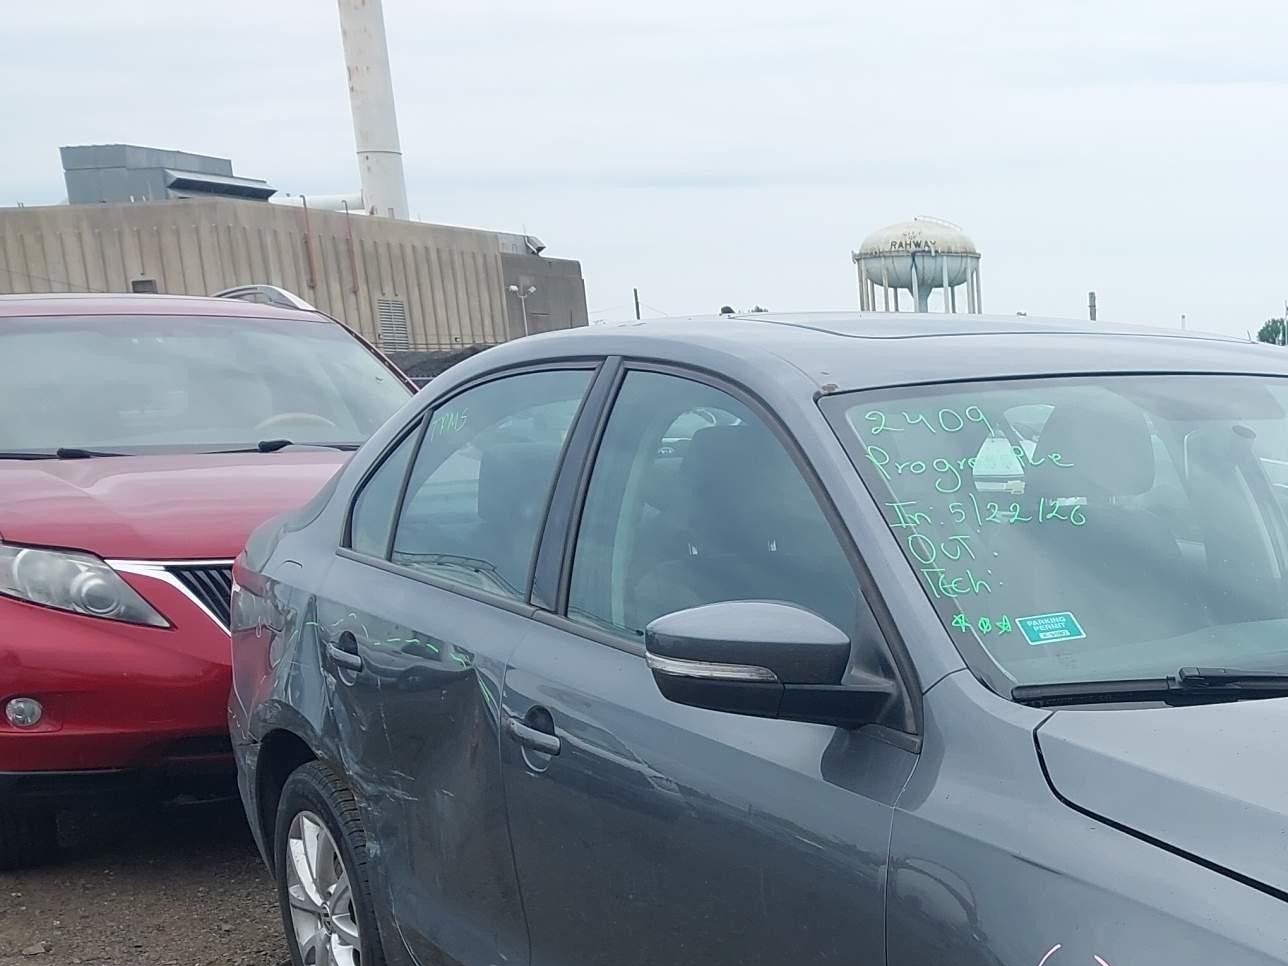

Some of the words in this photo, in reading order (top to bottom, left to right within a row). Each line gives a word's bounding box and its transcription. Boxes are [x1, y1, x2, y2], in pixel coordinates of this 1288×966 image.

[889, 240, 937, 250] RAHWAY
[864, 405, 996, 437] 2409
[1027, 616, 1066, 627] PARKING
[1034, 622, 1066, 631] PERMIT
